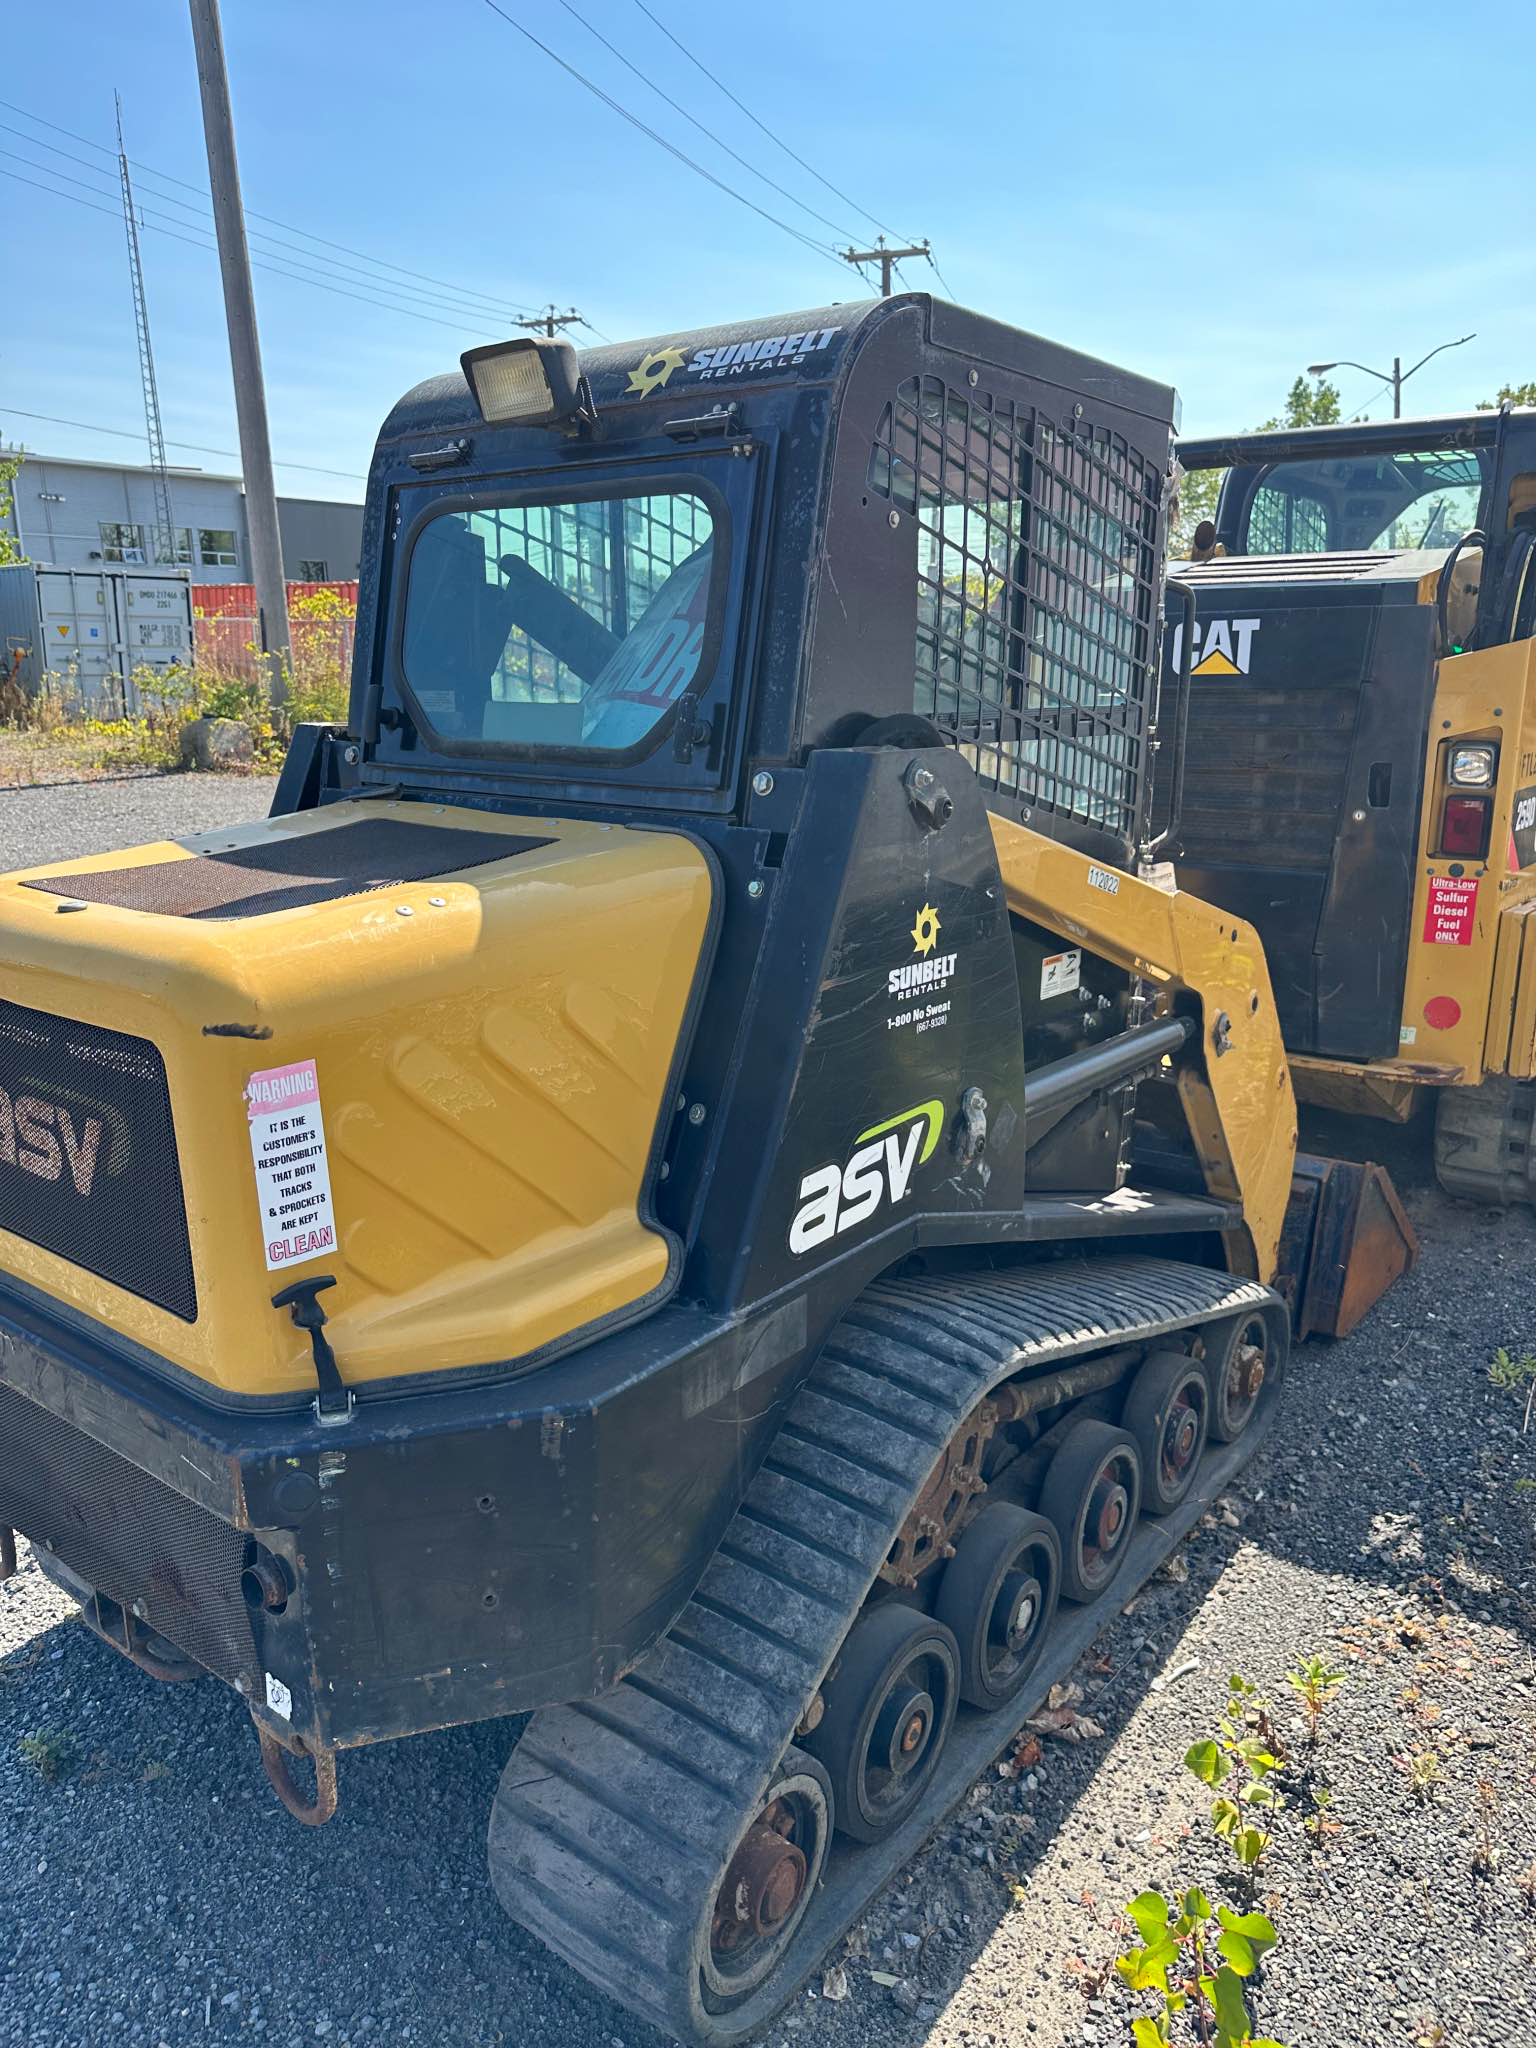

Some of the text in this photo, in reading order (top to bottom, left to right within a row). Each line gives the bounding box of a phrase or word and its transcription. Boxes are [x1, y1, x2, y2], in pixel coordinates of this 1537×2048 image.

[688, 326, 842, 371] SUNBELT
[700, 354, 806, 380] RENTALS
[1172, 618, 1261, 675] CAT
[1089, 868, 1119, 895] 112022
[1432, 878, 1477, 889] Ultra-Low
[1435, 891, 1469, 903] Sulfur
[1433, 904, 1468, 917] Diesel
[1437, 918, 1460, 930] Fuel
[1435, 931, 1460, 941] ONLY
[888, 953, 958, 993] SUNBELT
[897, 979, 947, 1001] RENTALS
[887, 1000, 951, 1030] 1-800 No Sweat
[248, 1070, 314, 1104] WARNING
[269, 1115, 306, 1134] IT IS THE
[262, 1130, 316, 1152] CUSTOMER'S
[258, 1144, 323, 1170] RESPONSIBILITY
[271, 1163, 316, 1184] THAT BOTH
[280, 1181, 313, 1198] TRACKS
[268, 1193, 326, 1218] & SPROCKETS
[281, 1211, 319, 1232] ARE KEPT
[268, 1225, 334, 1262] CLEAN
